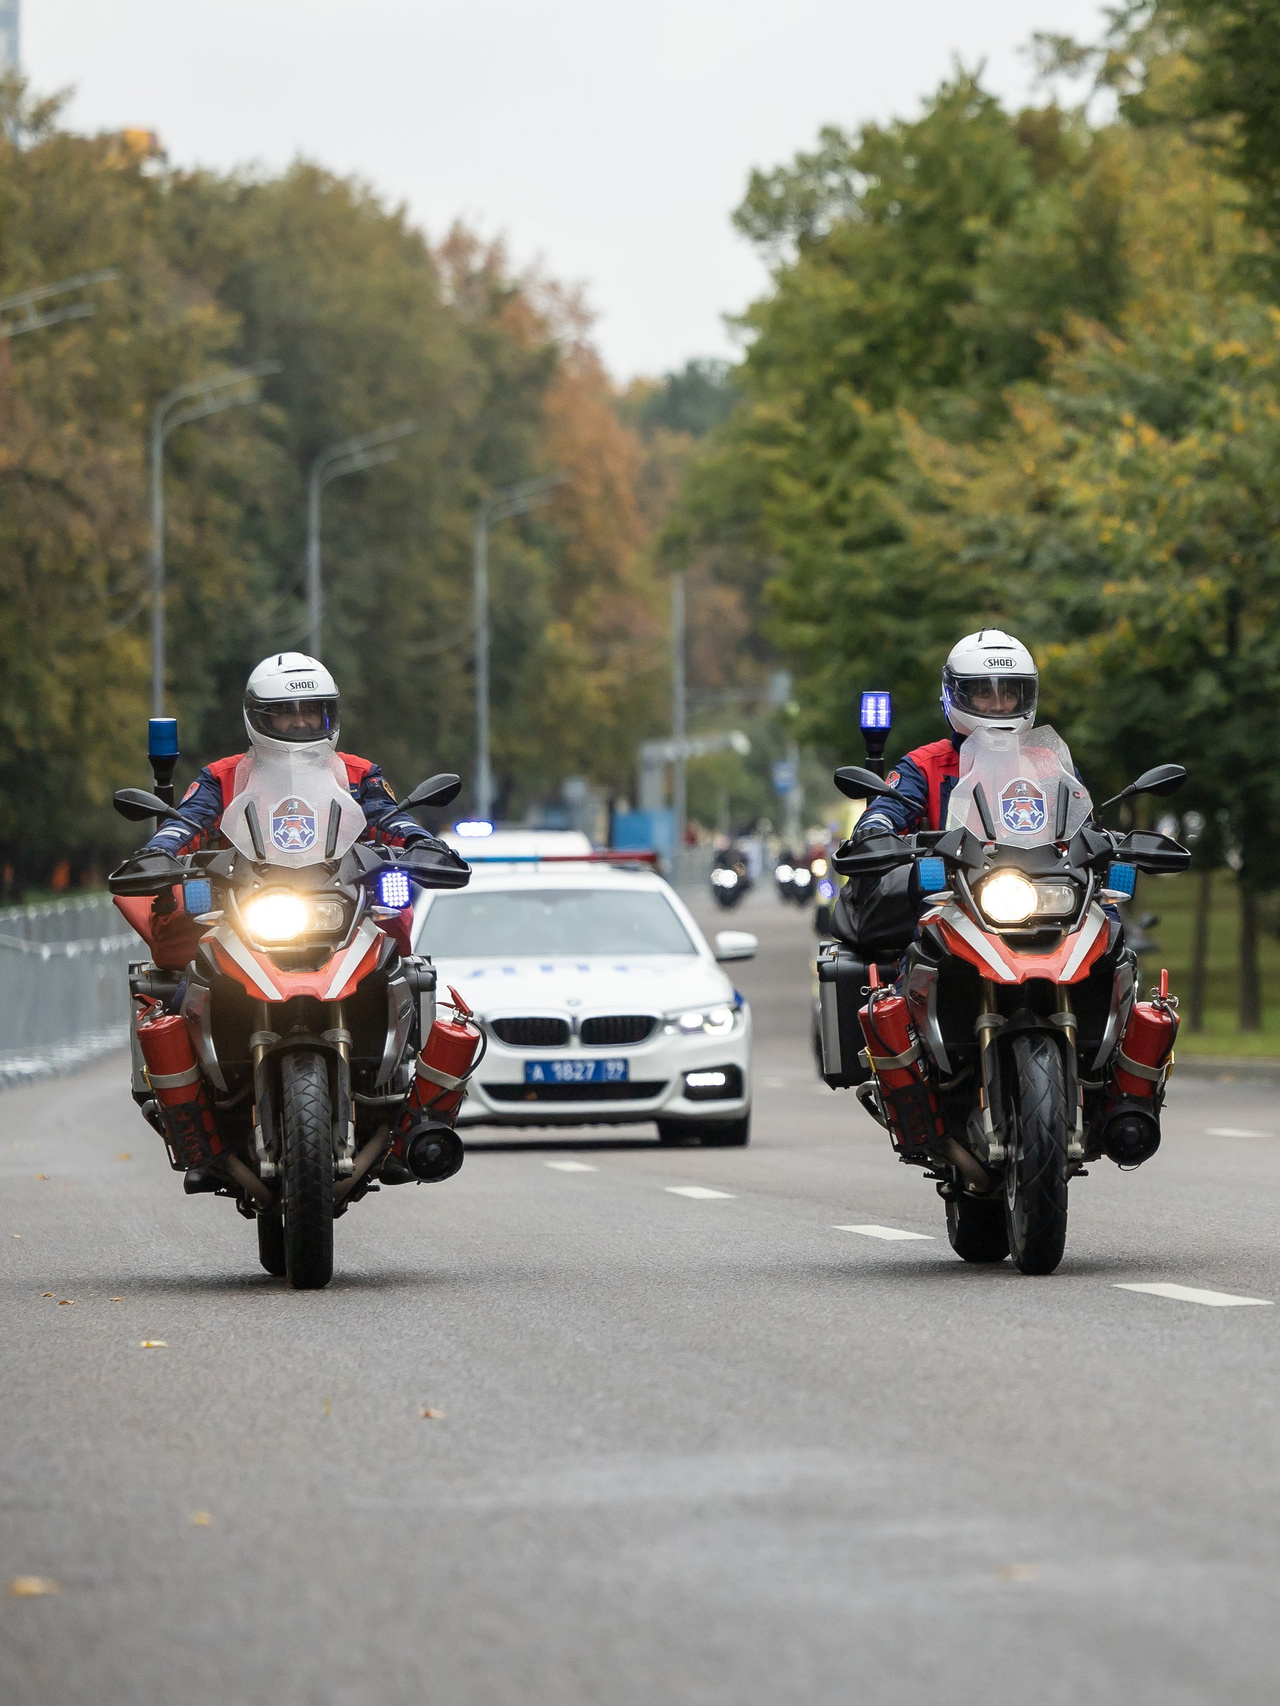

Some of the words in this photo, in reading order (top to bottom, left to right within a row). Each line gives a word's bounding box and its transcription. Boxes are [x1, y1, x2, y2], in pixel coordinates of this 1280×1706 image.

[988, 658, 1013, 667] SHOEI
[289, 681, 315, 690] SHOEI
[551, 1060, 596, 1081] 1827
